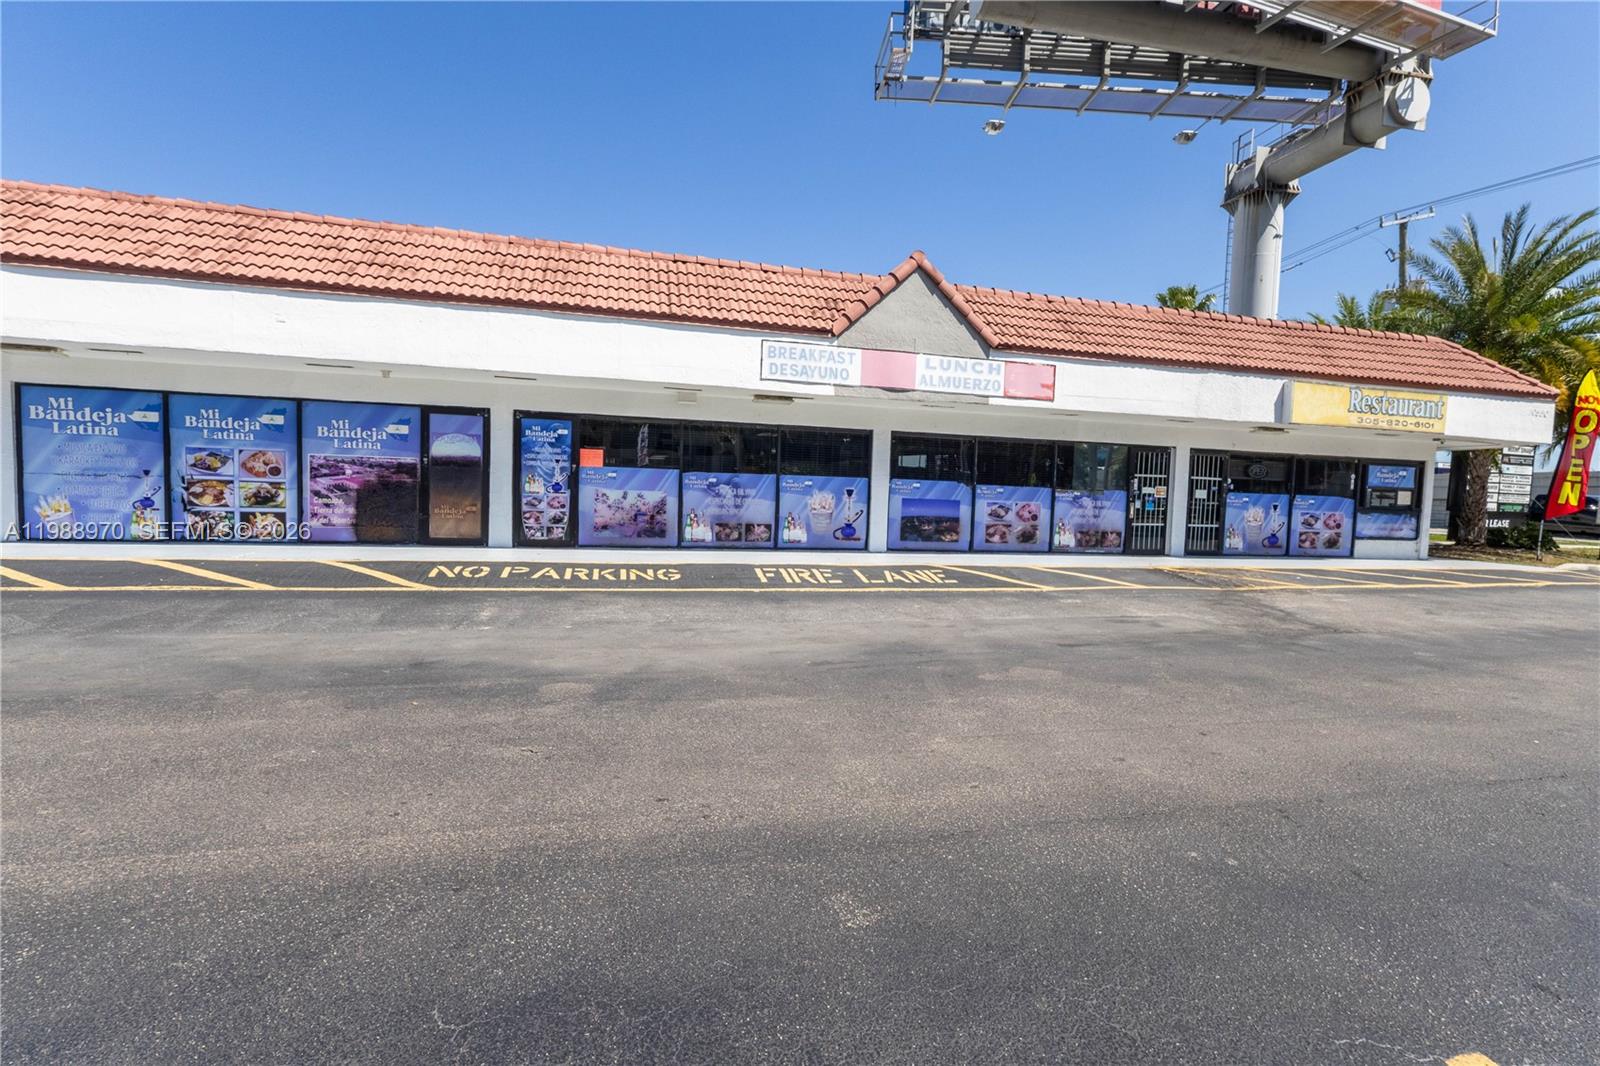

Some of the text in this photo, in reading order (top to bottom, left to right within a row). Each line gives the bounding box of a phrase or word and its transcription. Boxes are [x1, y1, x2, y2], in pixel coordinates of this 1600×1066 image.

[767, 344, 856, 365] BREAKFAST
[768, 362, 850, 381] DESAYUNO
[925, 357, 1002, 375] LUNCH
[919, 373, 1002, 392] ALMUERZO
[47, 397, 74, 411] Mi
[1348, 386, 1445, 420] Restaurant
[28, 404, 128, 426] Bandeja
[199, 408, 220, 421] Mi
[1357, 416, 1435, 429] 305-820-6101
[52, 421, 120, 437] Latina
[184, 415, 262, 432] Bandeja
[330, 419, 350, 430] Mi
[202, 428, 255, 441] Latina
[316, 424, 388, 441] Bandeja
[524, 429, 559, 438] Bandeja
[333, 438, 382, 450] Latina
[1557, 409, 1599, 507] OPEN
[1489, 519, 1510, 529] LEASE
[427, 564, 957, 585] NO PARKING FIRE LANE
